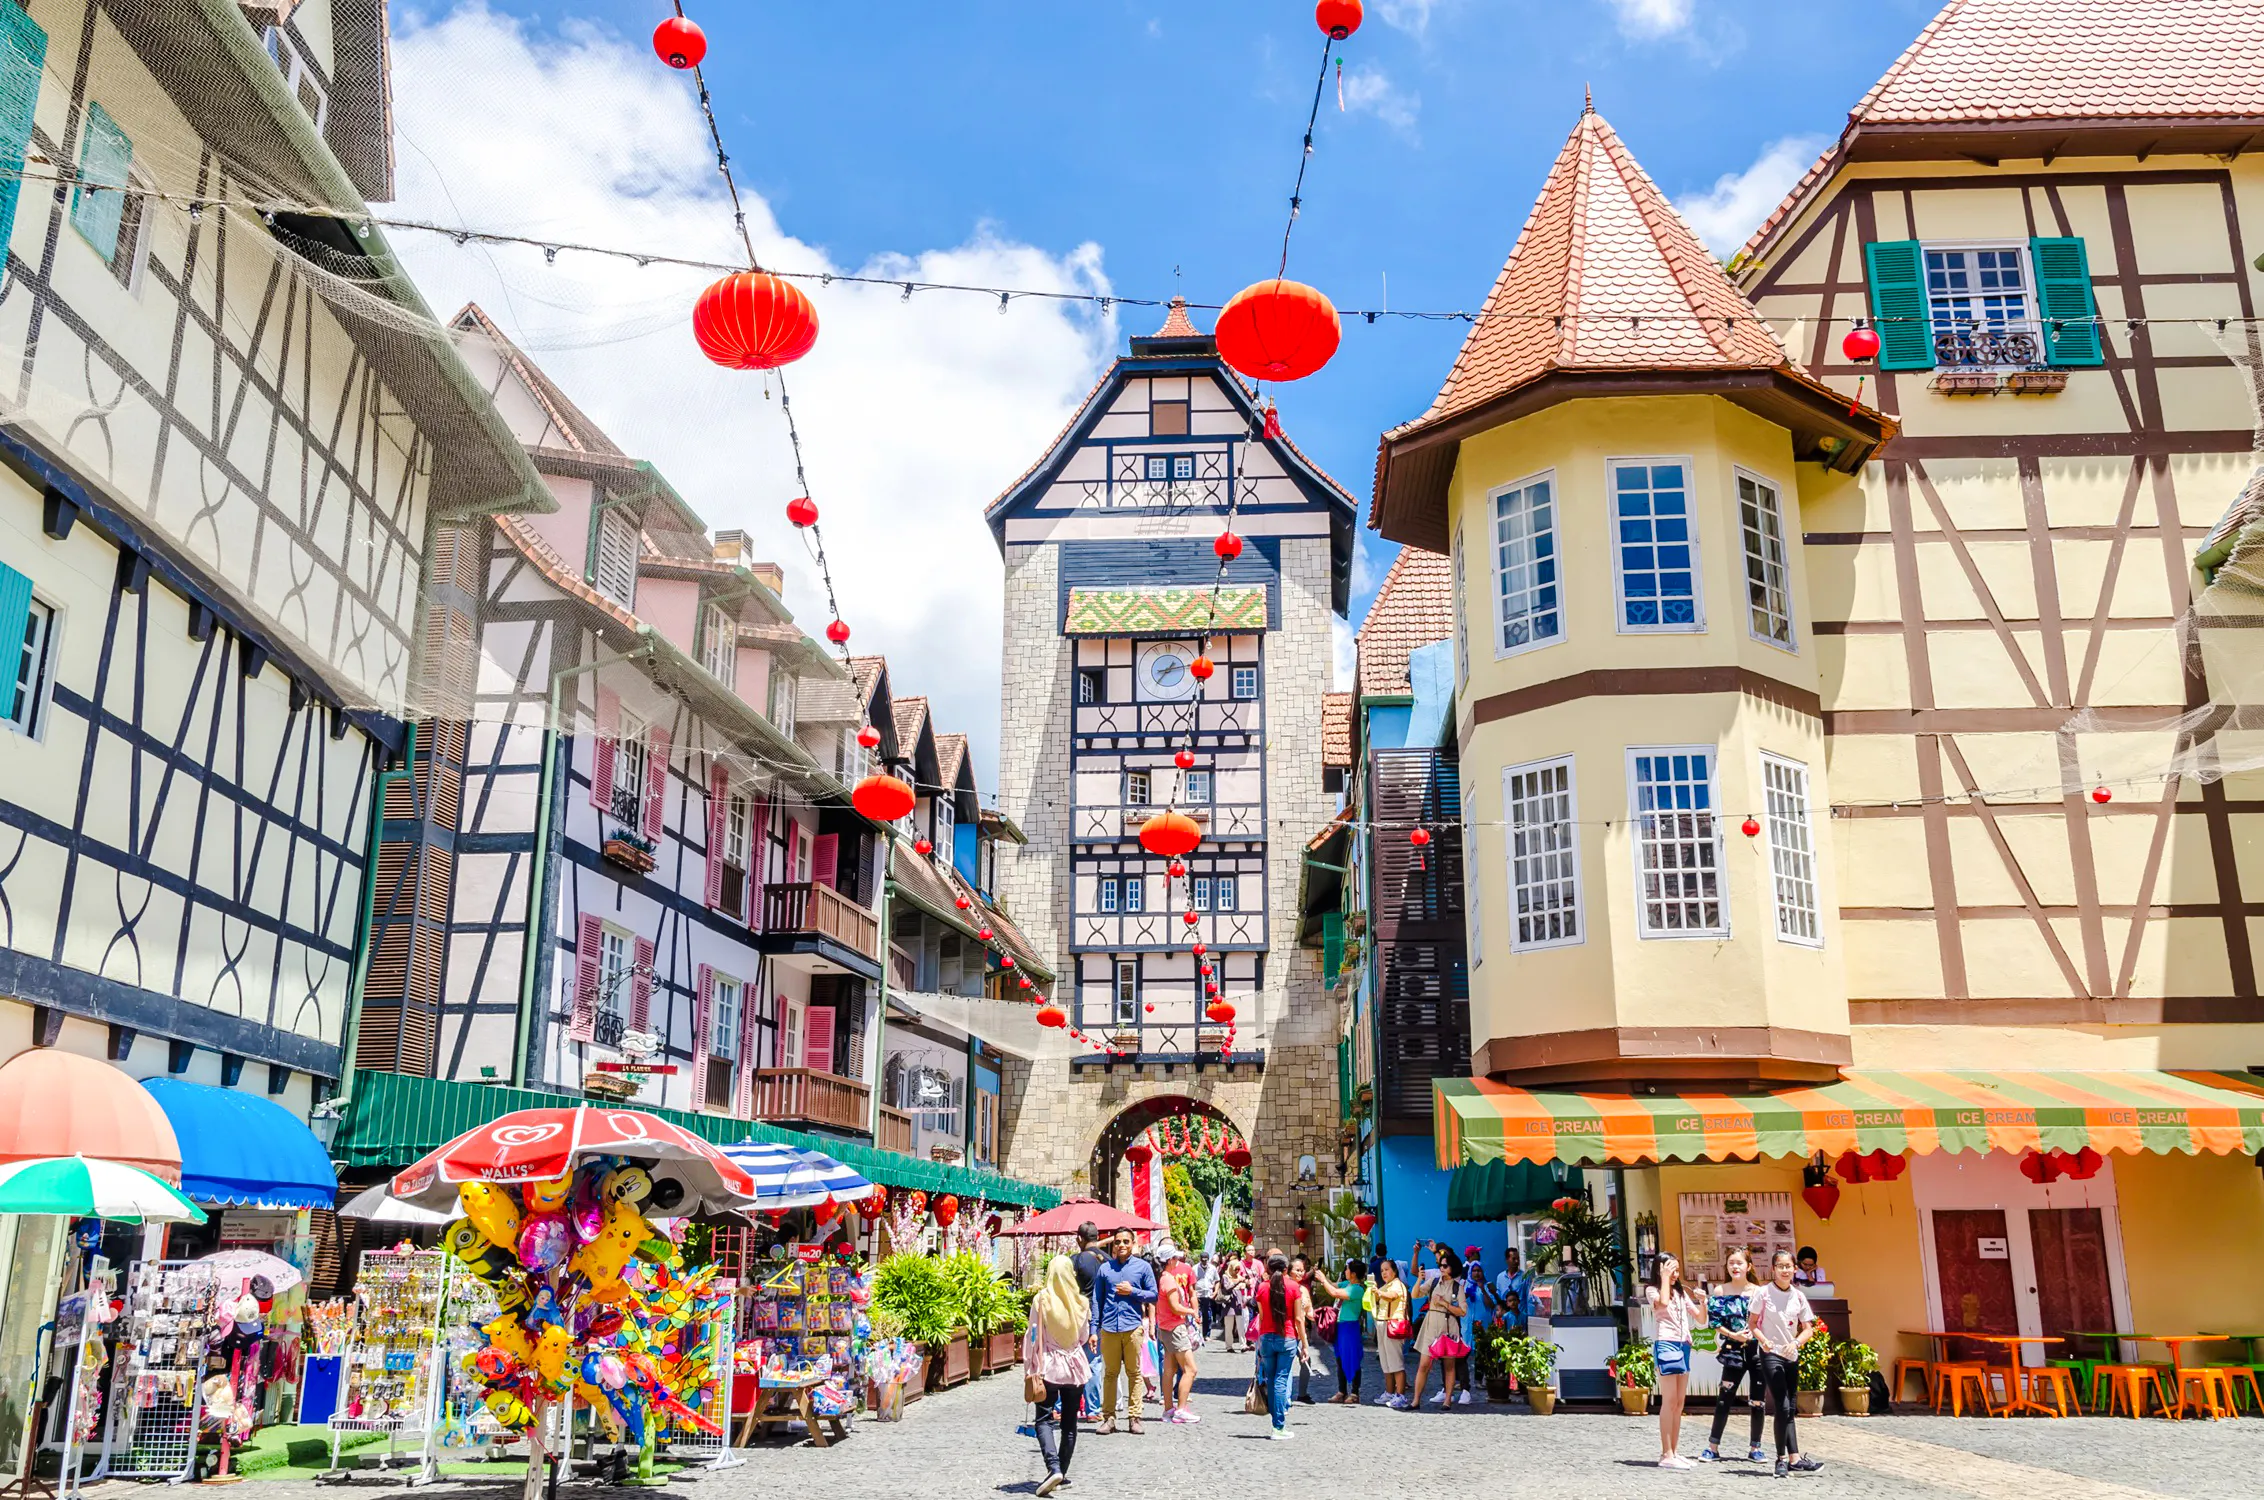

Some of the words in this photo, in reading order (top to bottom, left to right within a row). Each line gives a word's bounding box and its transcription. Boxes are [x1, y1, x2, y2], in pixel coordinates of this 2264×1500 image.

[1676, 1118, 1699, 1131] ICE
[1703, 1117, 1754, 1130] CREAM
[1826, 1114, 1850, 1126] ICE
[1854, 1113, 1905, 1125] CREAM
[1957, 1112, 1981, 1124] ICE
[1984, 1112, 2036, 1123] CREAM
[2108, 1112, 2132, 1123] ICE
[2136, 1112, 2189, 1123] CREAM
[1525, 1121, 1548, 1133] ICE
[1553, 1120, 1604, 1133] CREAM
